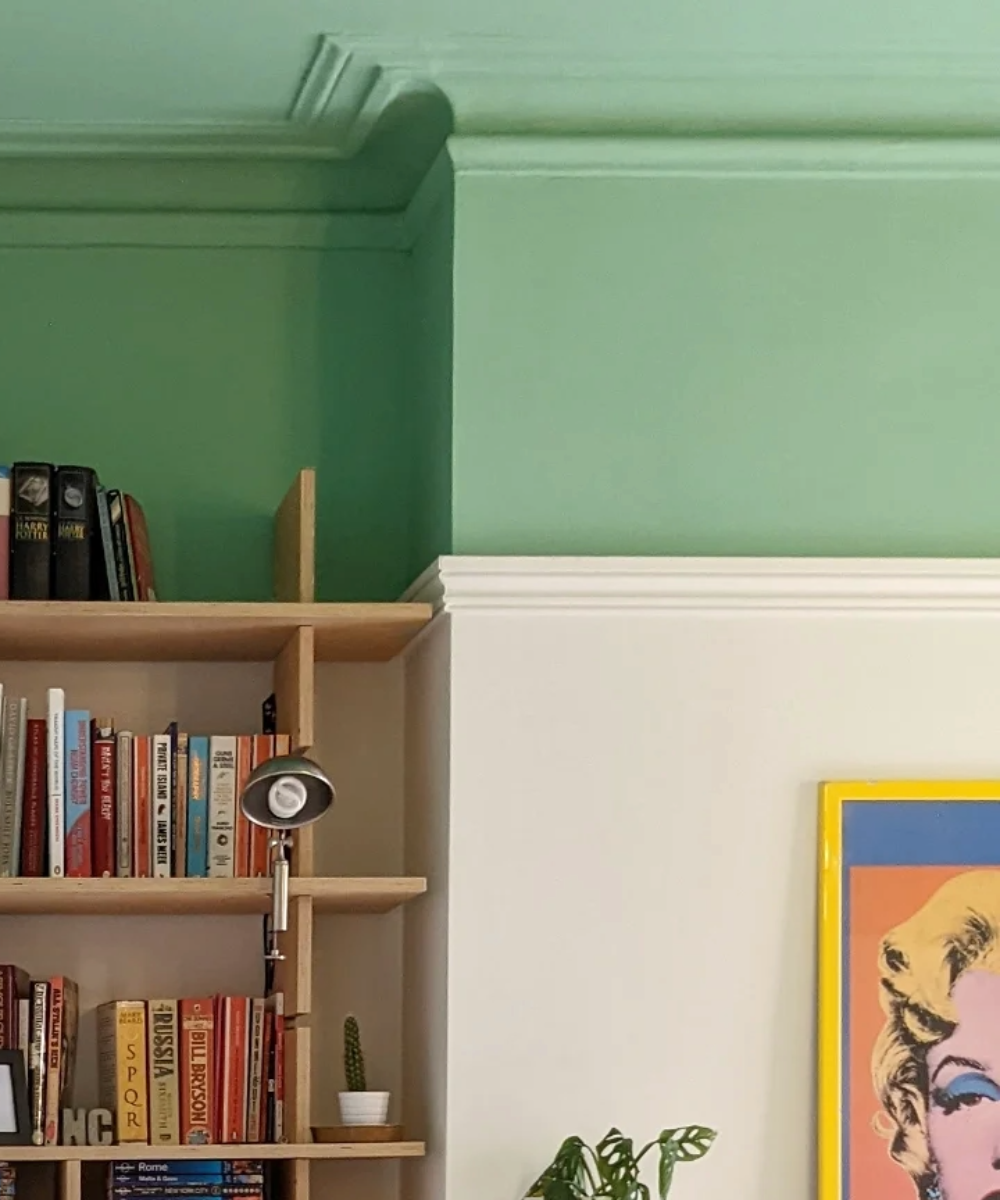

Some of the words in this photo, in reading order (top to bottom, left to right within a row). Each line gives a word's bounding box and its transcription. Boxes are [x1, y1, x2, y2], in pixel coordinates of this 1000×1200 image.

[15, 531, 48, 540] POTTER
[16, 522, 48, 531] HARRY
[7, 703, 18, 733] DAVID
[156, 742, 168, 771] PRIVATE
[156, 774, 168, 799] ISLAND
[156, 820, 168, 843] JAMES
[156, 845, 168, 865] MEEK
[53, 988, 61, 1005] ALL
[152, 1013, 175, 1078] RUSSIA
[190, 1031, 206, 1061] BILL
[190, 1063, 207, 1122] BRYSON
[138, 1162, 168, 1172] Rome
